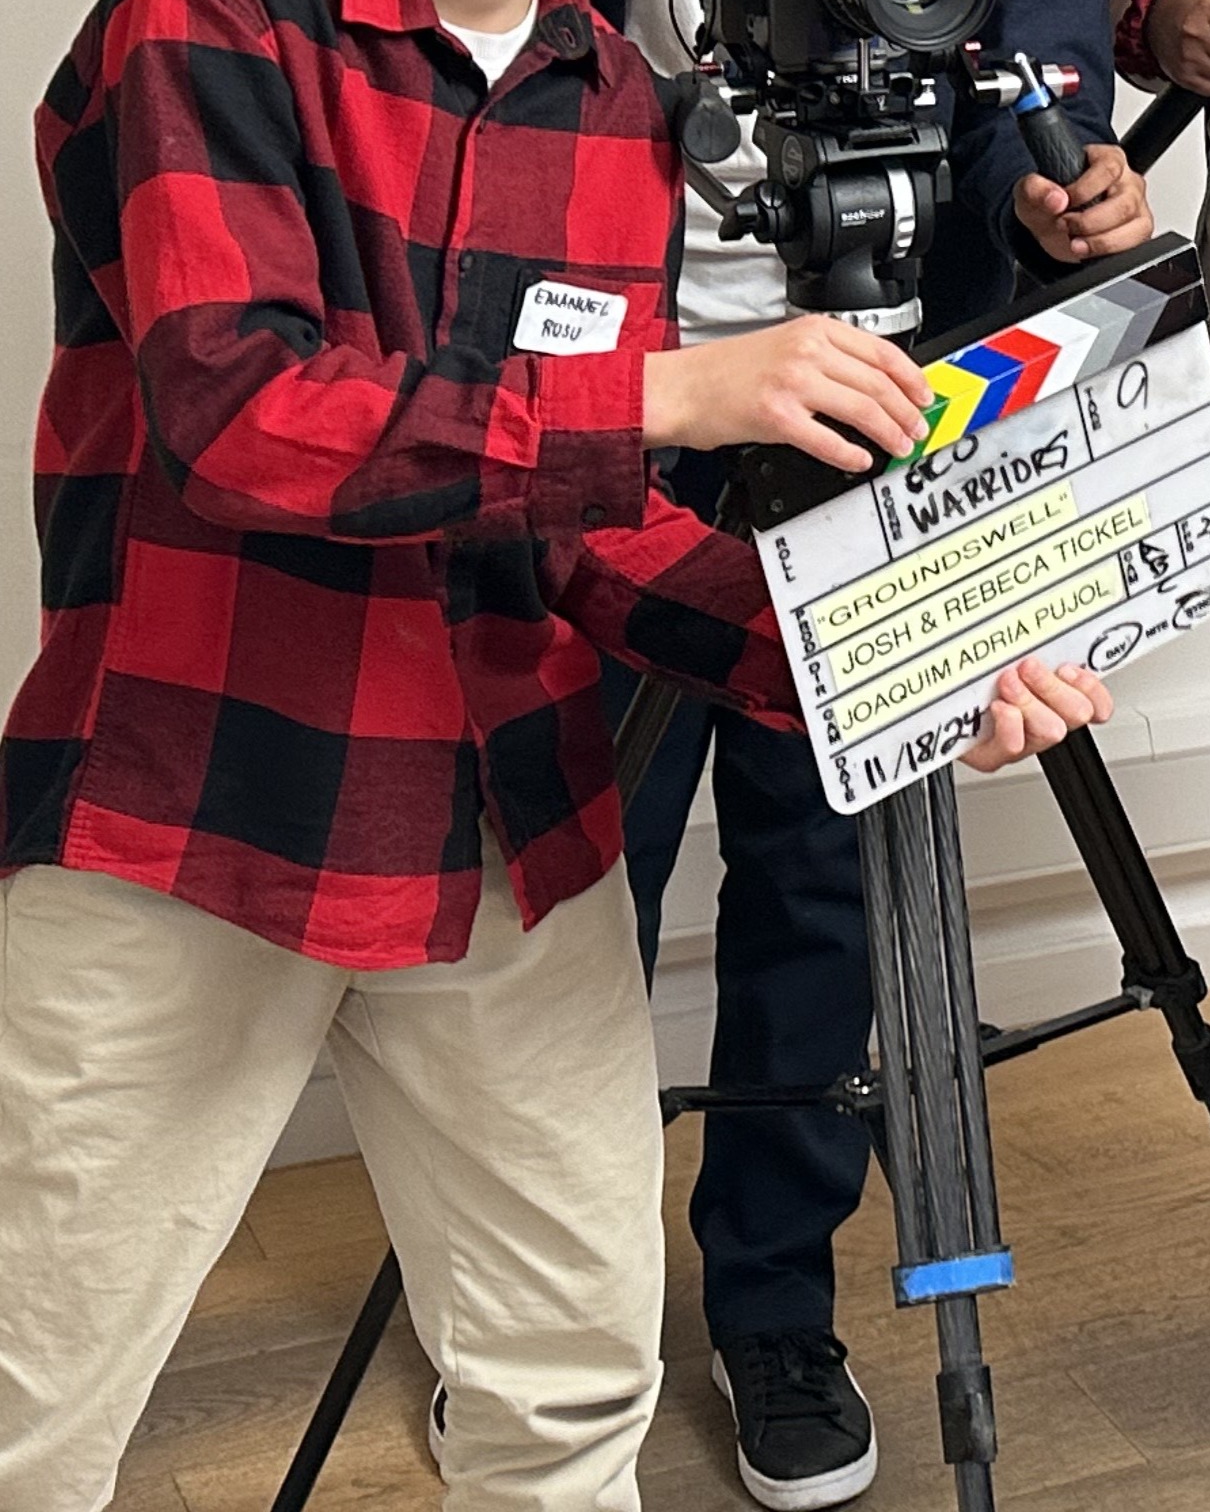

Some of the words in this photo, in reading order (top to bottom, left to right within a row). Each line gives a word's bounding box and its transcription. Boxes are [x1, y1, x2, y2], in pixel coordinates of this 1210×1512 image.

[842, 621, 913, 675] JOSH
[921, 610, 939, 635] &
[944, 553, 1050, 623] REBECA
[1053, 506, 1144, 564] TICKEL
[842, 657, 952, 731] JOAQUIM
[959, 619, 1031, 672] ADRIA
[1034, 579, 1112, 630] PUJOL
